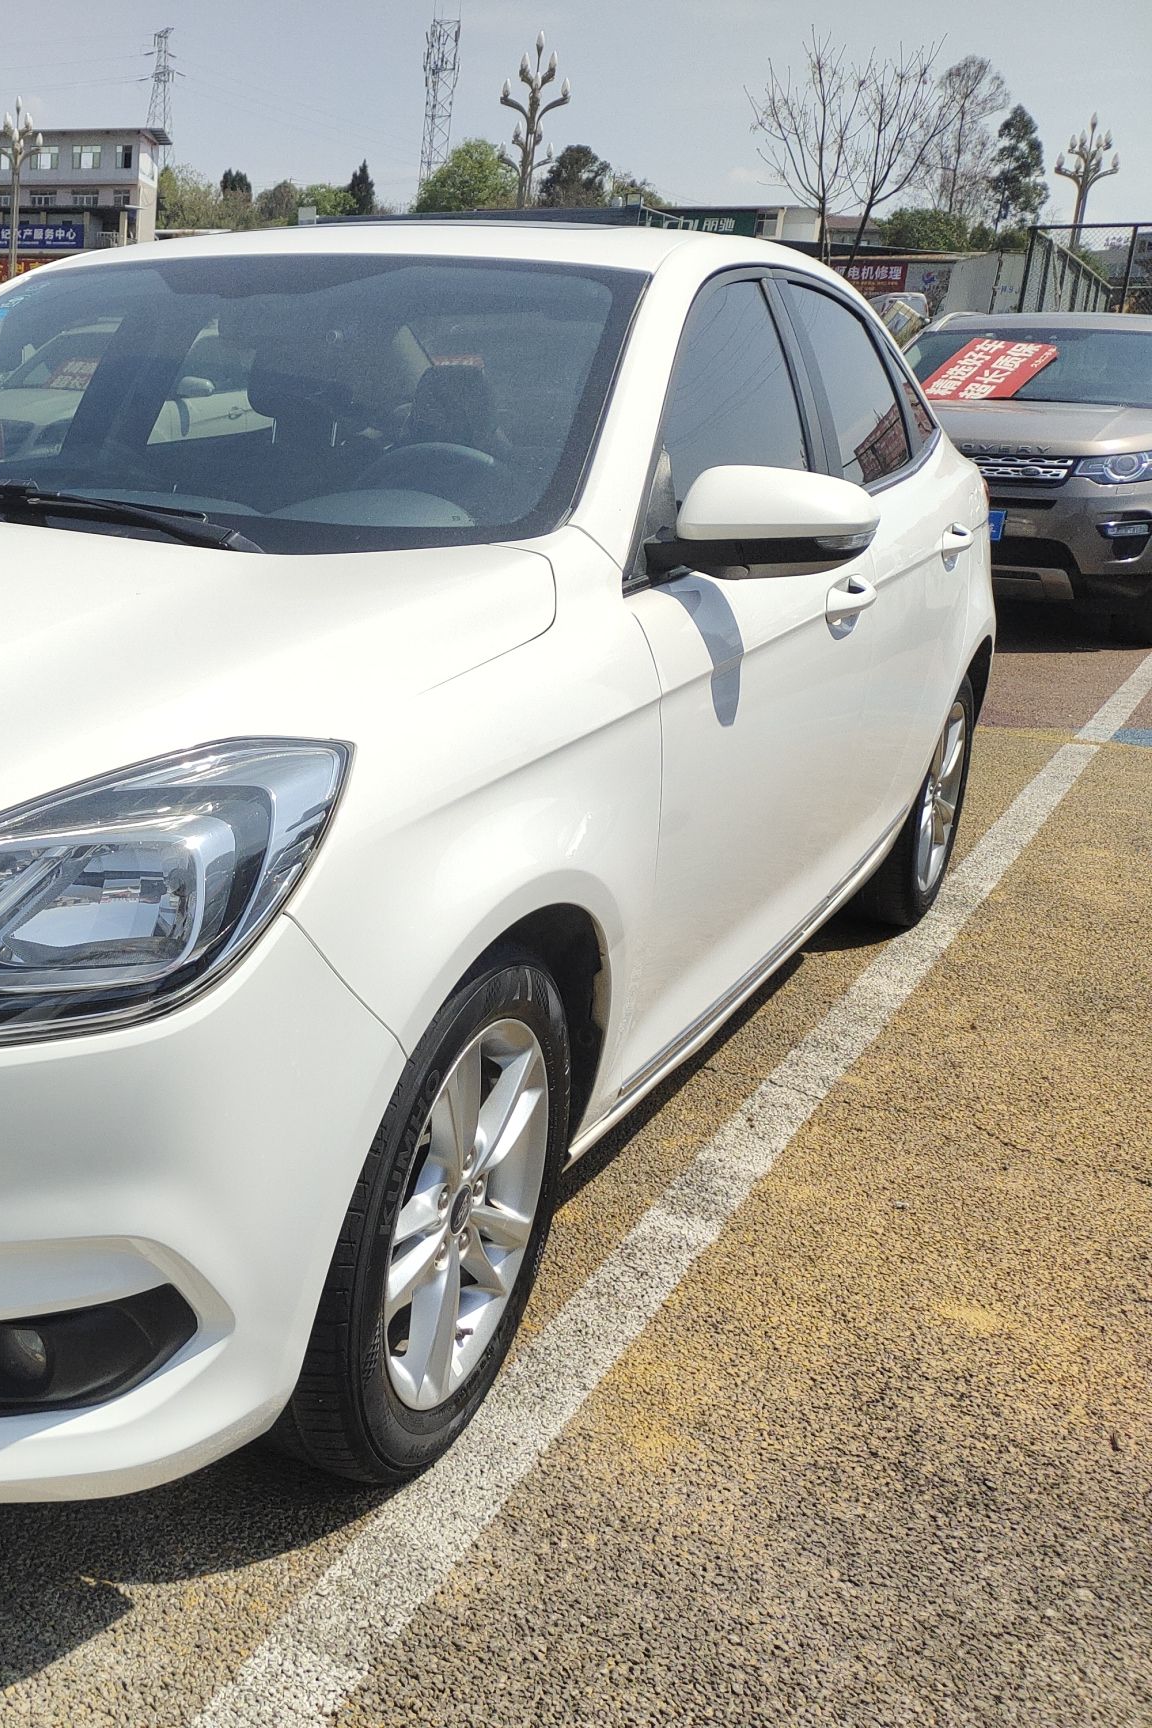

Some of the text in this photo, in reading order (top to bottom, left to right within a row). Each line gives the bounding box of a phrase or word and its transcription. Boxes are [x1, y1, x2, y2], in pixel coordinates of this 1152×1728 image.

[925, 339, 1006, 396] 精选好车
[958, 342, 1043, 399] 超长质保
[379, 1069, 440, 1236] KUMHO
